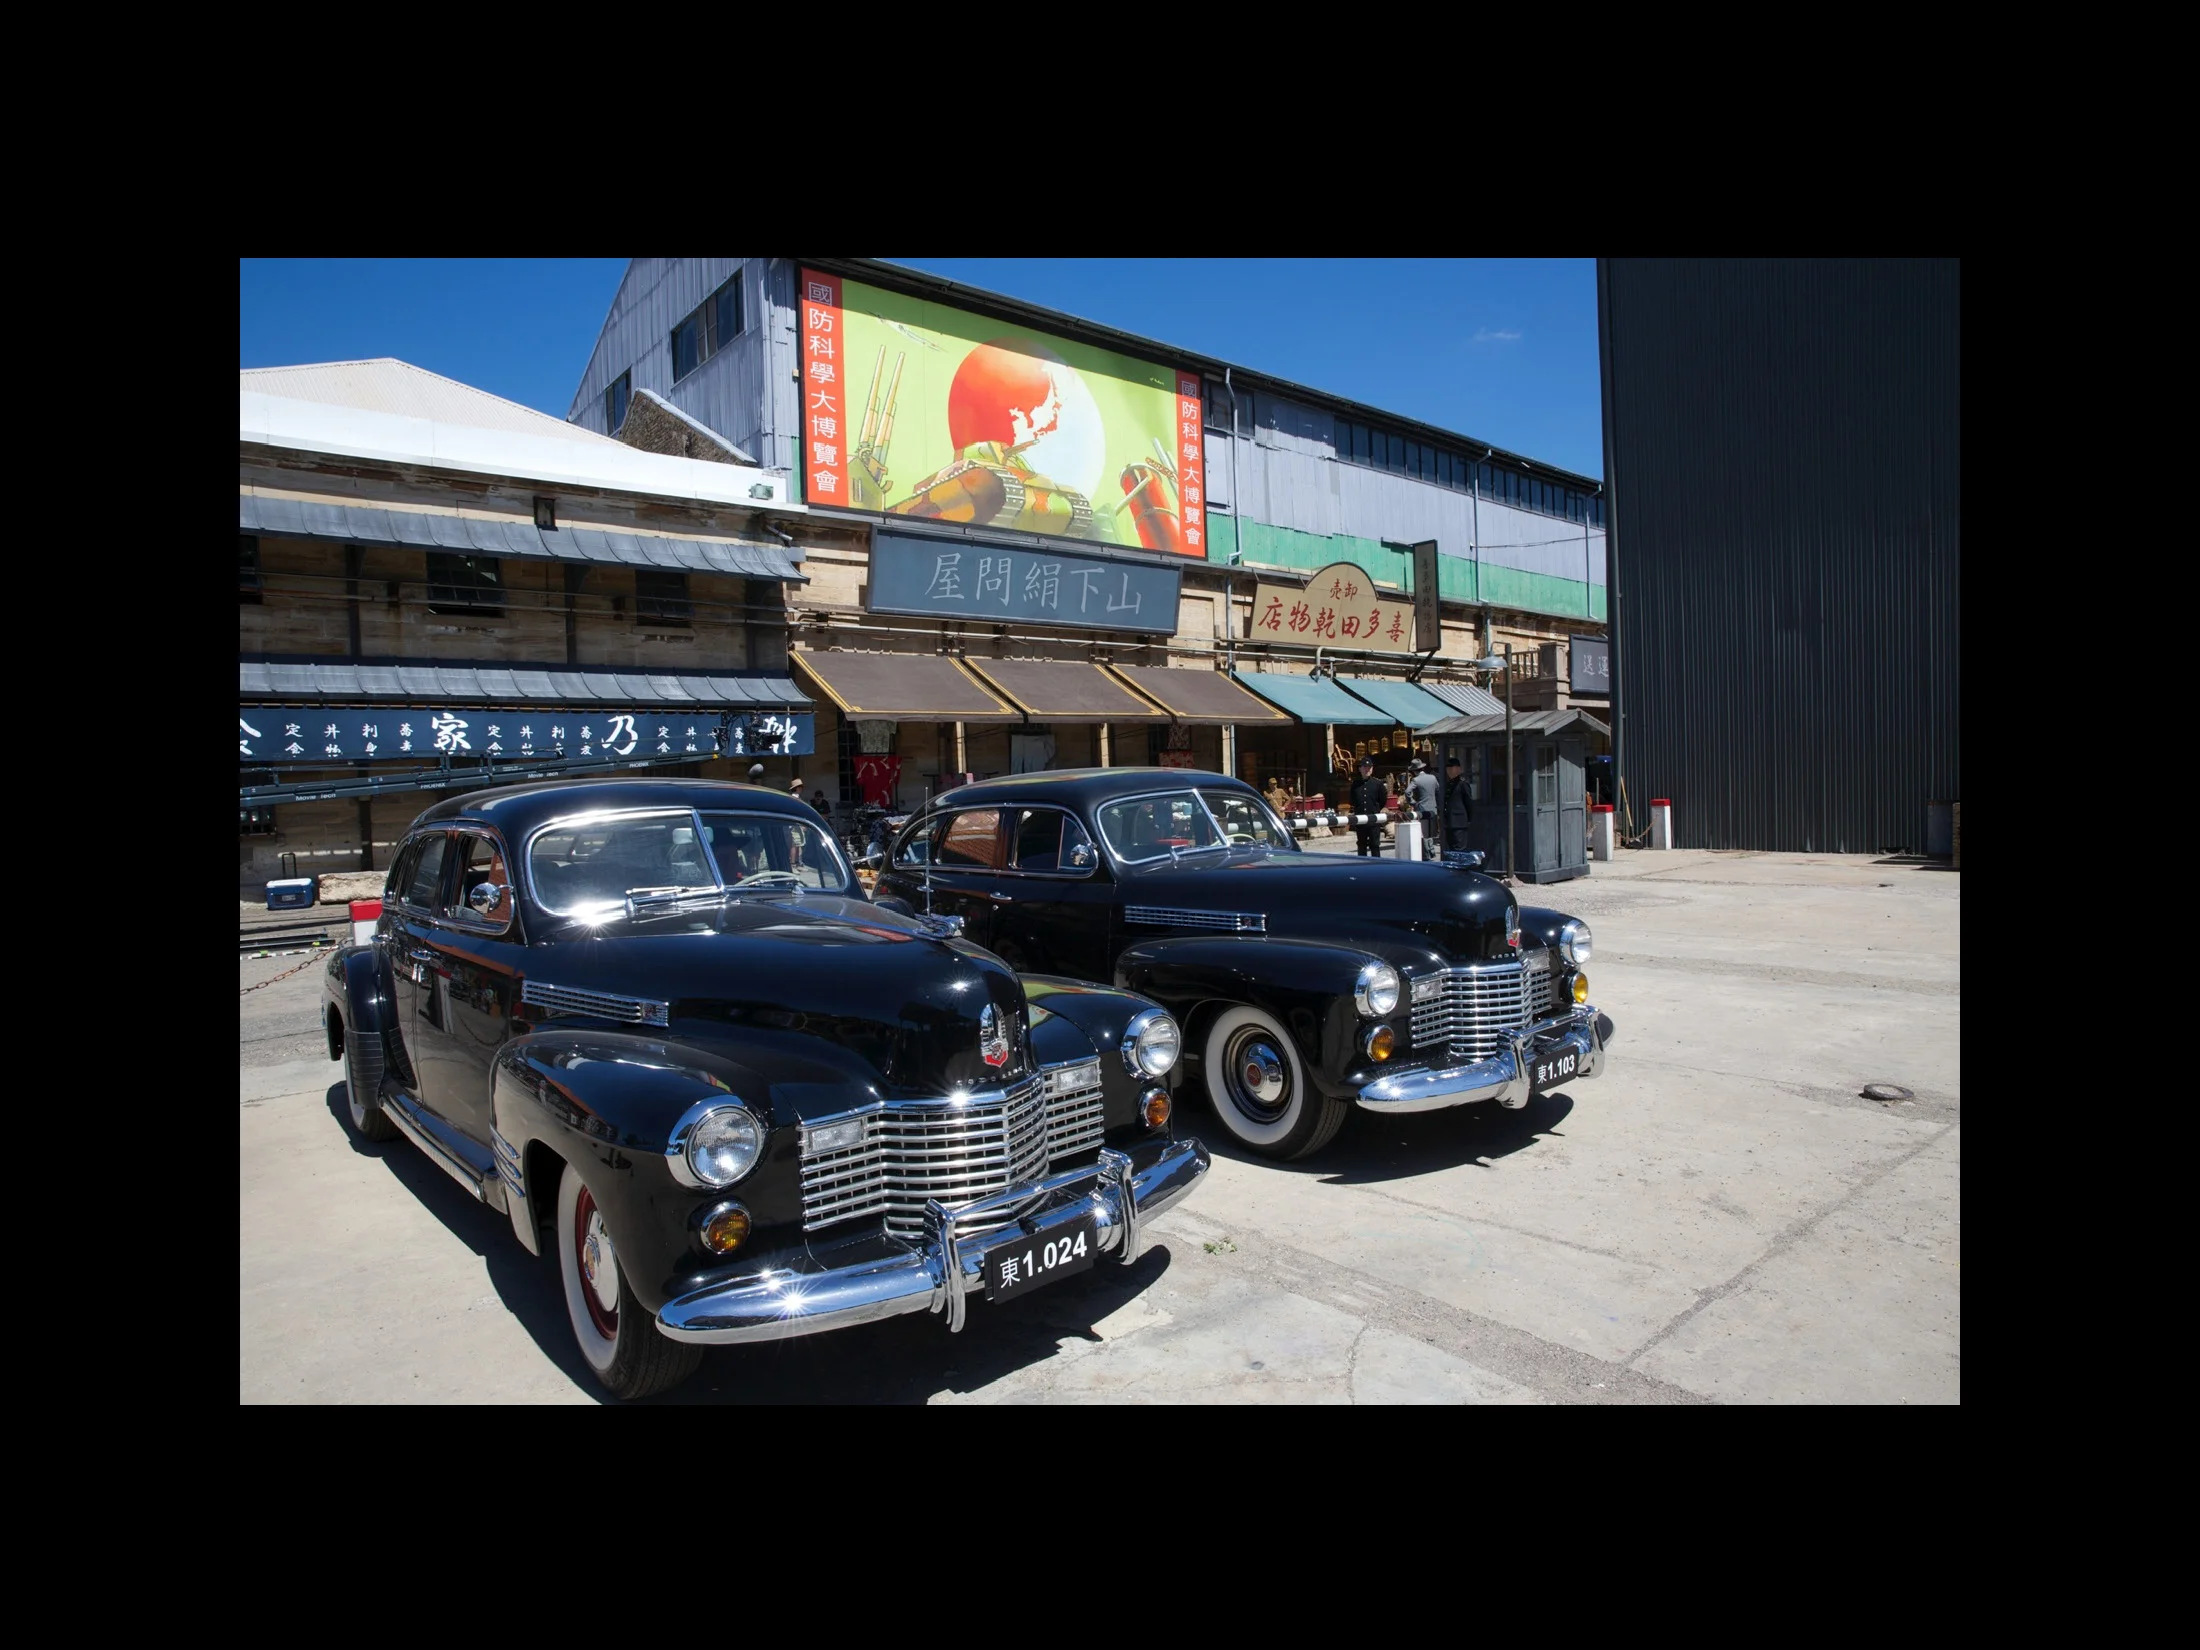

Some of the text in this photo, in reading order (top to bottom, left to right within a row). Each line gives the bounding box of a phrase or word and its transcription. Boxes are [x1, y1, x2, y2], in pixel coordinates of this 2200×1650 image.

[808, 281, 839, 493] 國防科學大博覽會
[1181, 380, 1201, 546] 國防科學大博覽會
[601, 714, 639, 755] 乃
